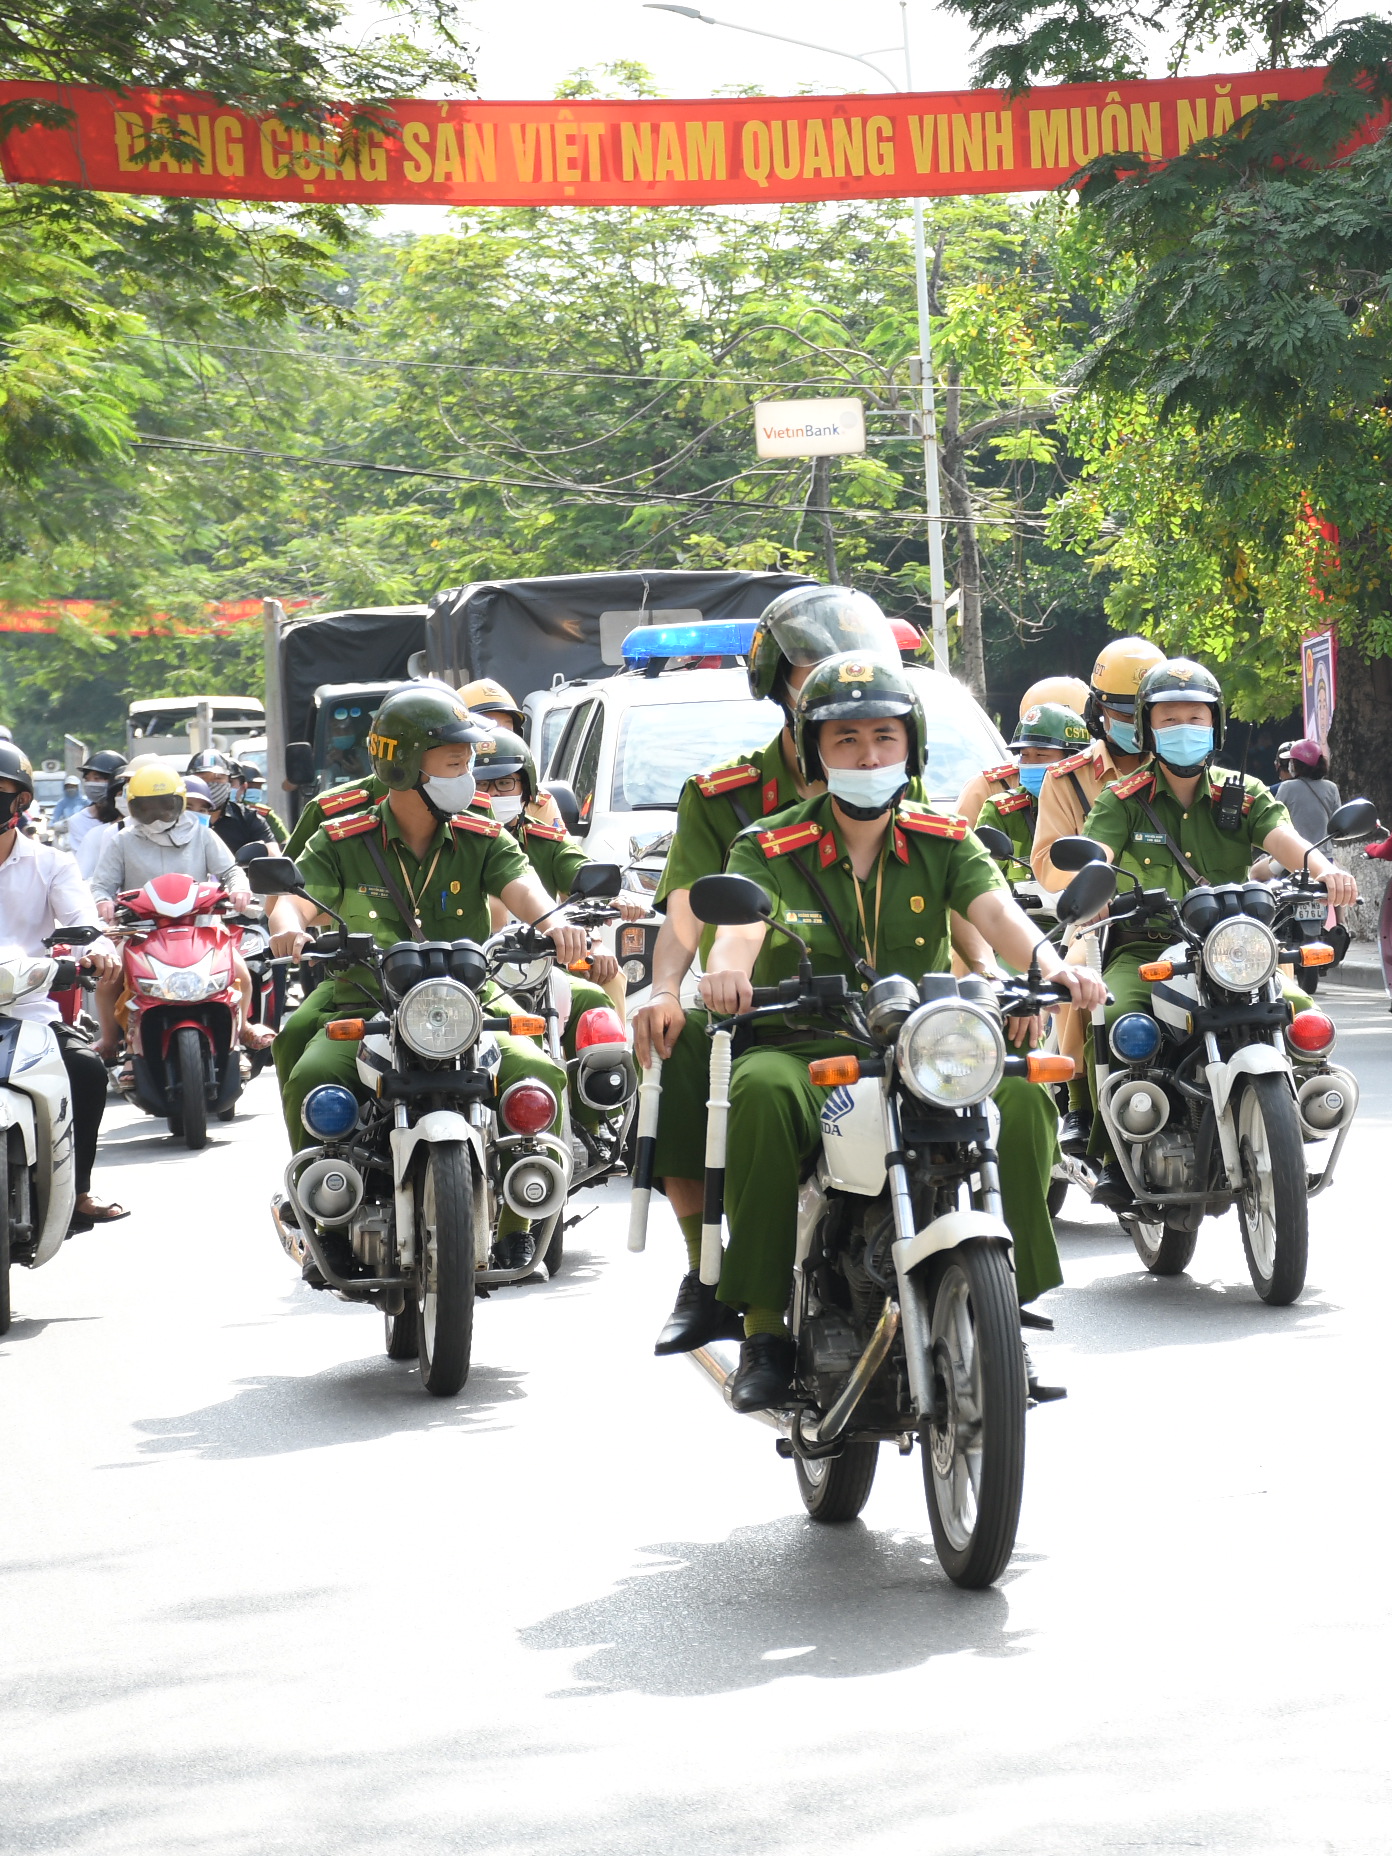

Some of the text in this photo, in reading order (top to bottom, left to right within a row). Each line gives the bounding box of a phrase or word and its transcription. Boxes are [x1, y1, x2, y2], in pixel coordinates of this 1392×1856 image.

[403, 101, 498, 183] SẢN
[509, 109, 605, 196] VIỆT
[620, 121, 727, 181] NAM
[742, 115, 895, 188] QUANG
[908, 110, 1014, 174] VINH
[1029, 91, 1163, 169] MUÔN
[763, 424, 840, 439] VietinBank
[369, 733, 398, 760] STT
